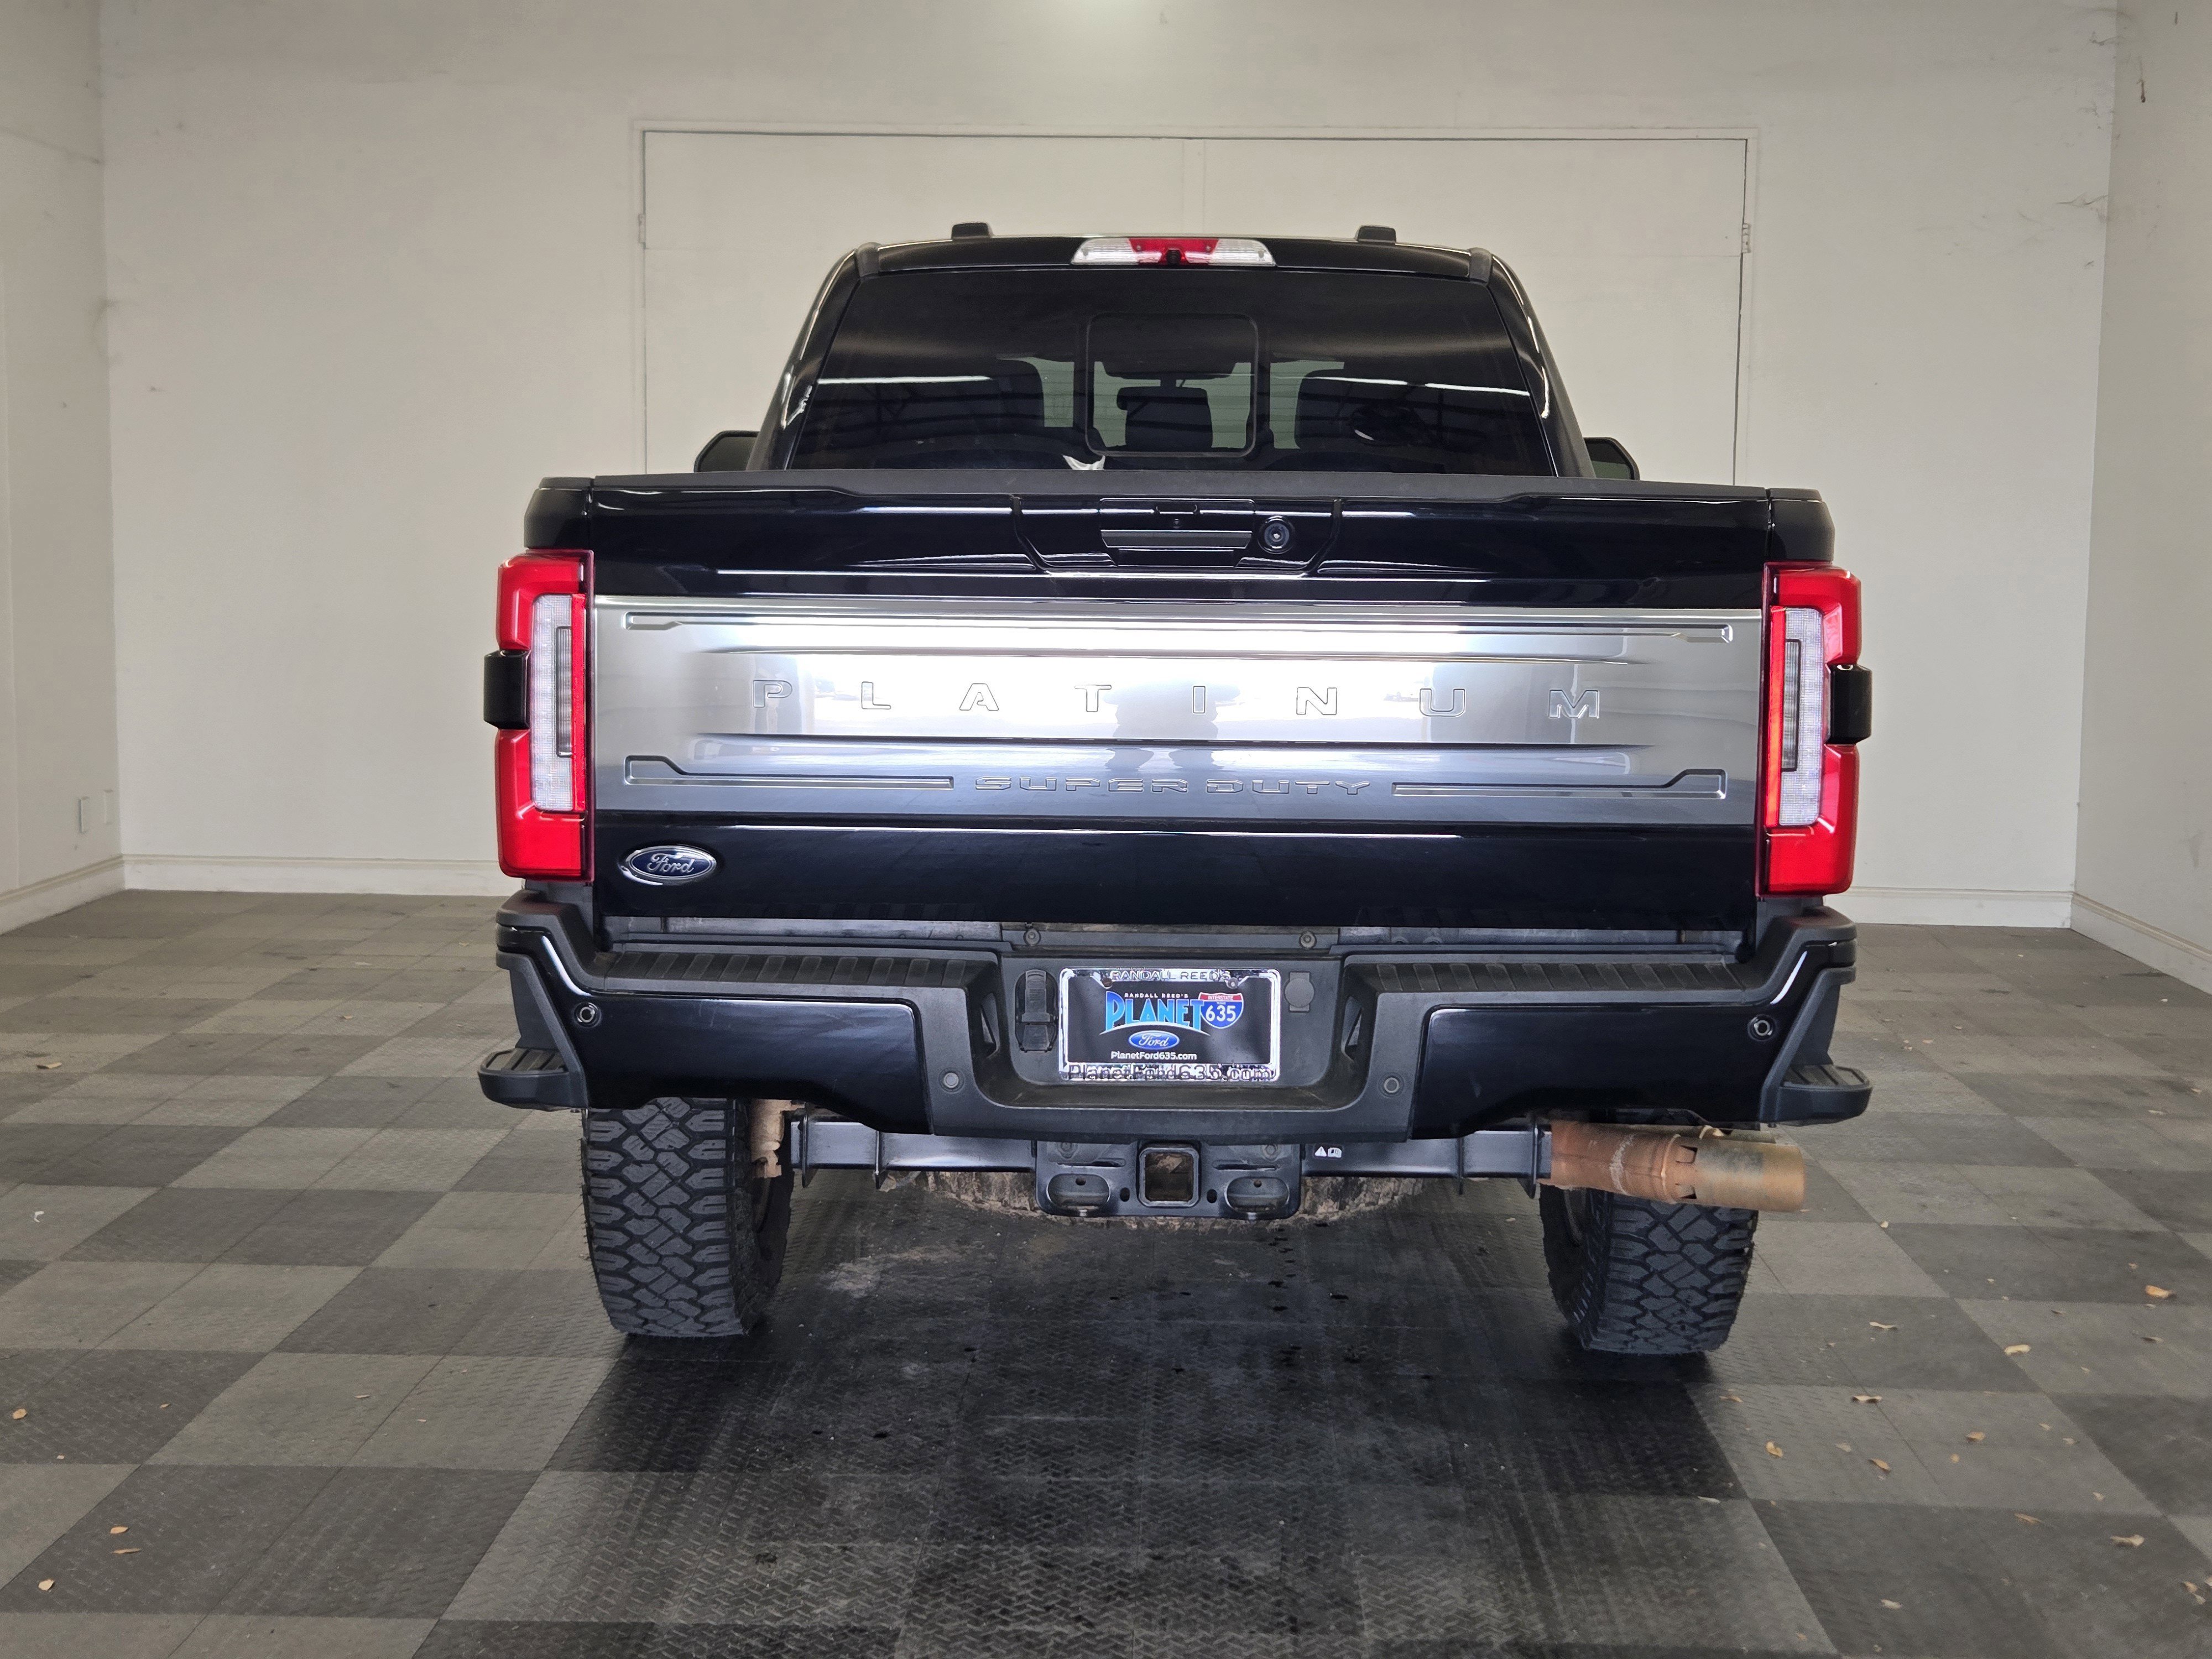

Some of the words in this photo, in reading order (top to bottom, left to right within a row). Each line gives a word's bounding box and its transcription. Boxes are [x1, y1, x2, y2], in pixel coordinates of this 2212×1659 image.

[753, 679, 1600, 719] PLATINUM
[975, 776, 1188, 793] SUPER
[1206, 779, 1370, 795] DUTY
[646, 853, 695, 873] Ford
[1112, 970, 1176, 980] RANDALL
[1105, 991, 1204, 1031] PLANET
[1206, 1005, 1236, 1022] 635
[1138, 1032, 1170, 1047] Ford
[1110, 1051, 1197, 1060] PlanetFord635.com
